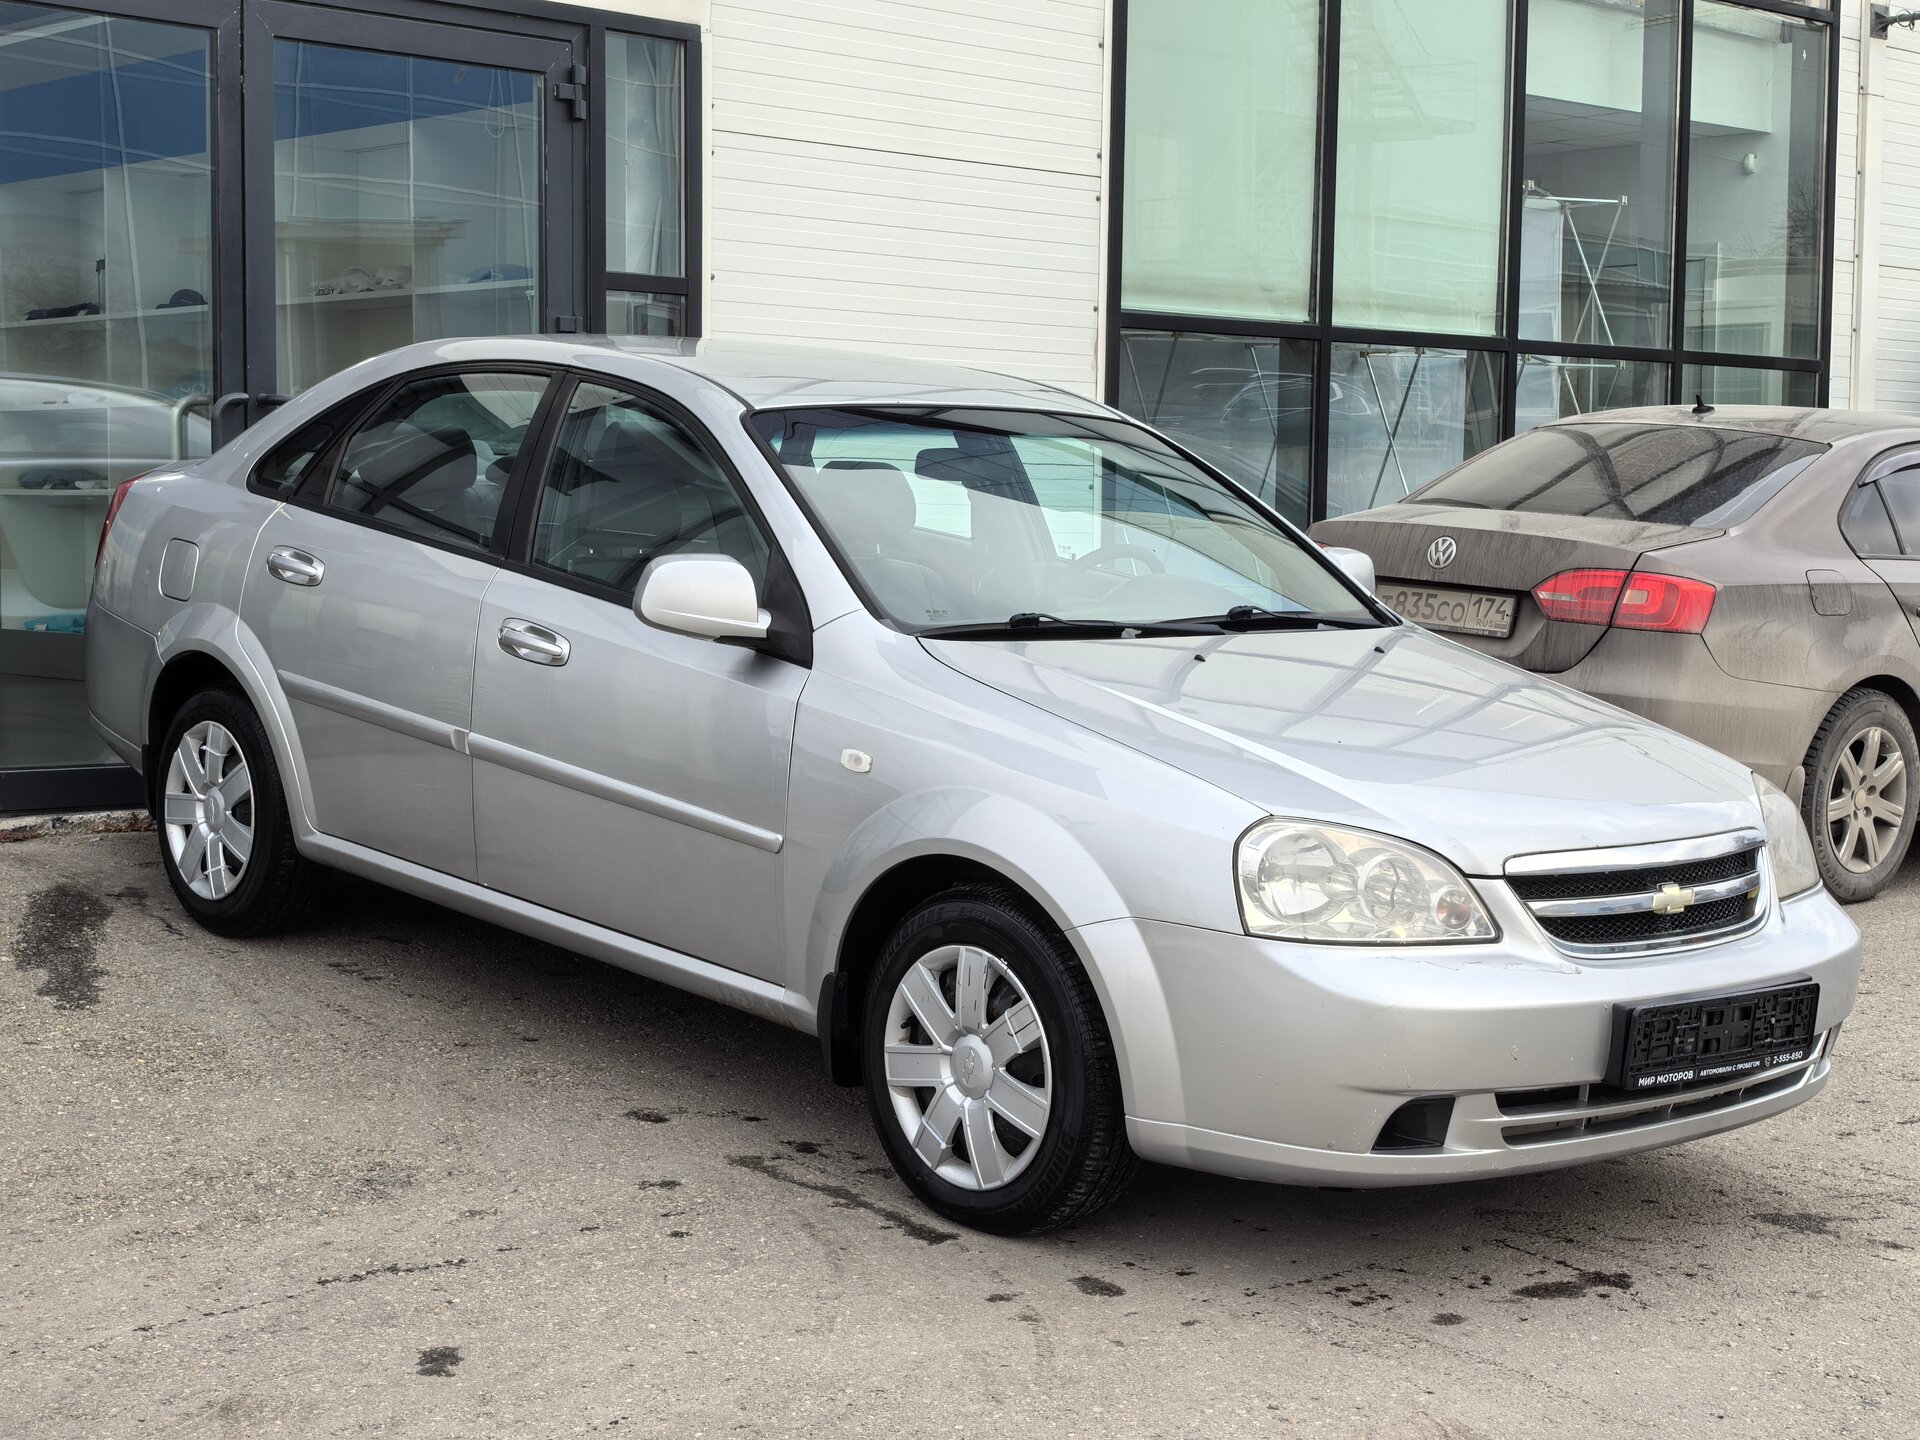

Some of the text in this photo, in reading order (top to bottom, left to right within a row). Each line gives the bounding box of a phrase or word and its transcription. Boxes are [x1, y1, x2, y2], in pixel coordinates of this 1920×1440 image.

[1473, 597, 1507, 621] 174
[1476, 619, 1494, 628] RUS
[1773, 1050, 1803, 1064] 2-555-850
[1638, 1076, 1655, 1087] МИР
[1656, 1070, 1694, 1084] МОТОРОВ
[1699, 1066, 1732, 1077] АВТОМОБИЛИ
[1736, 1060, 1760, 1071] ПРОБЕГОМ
